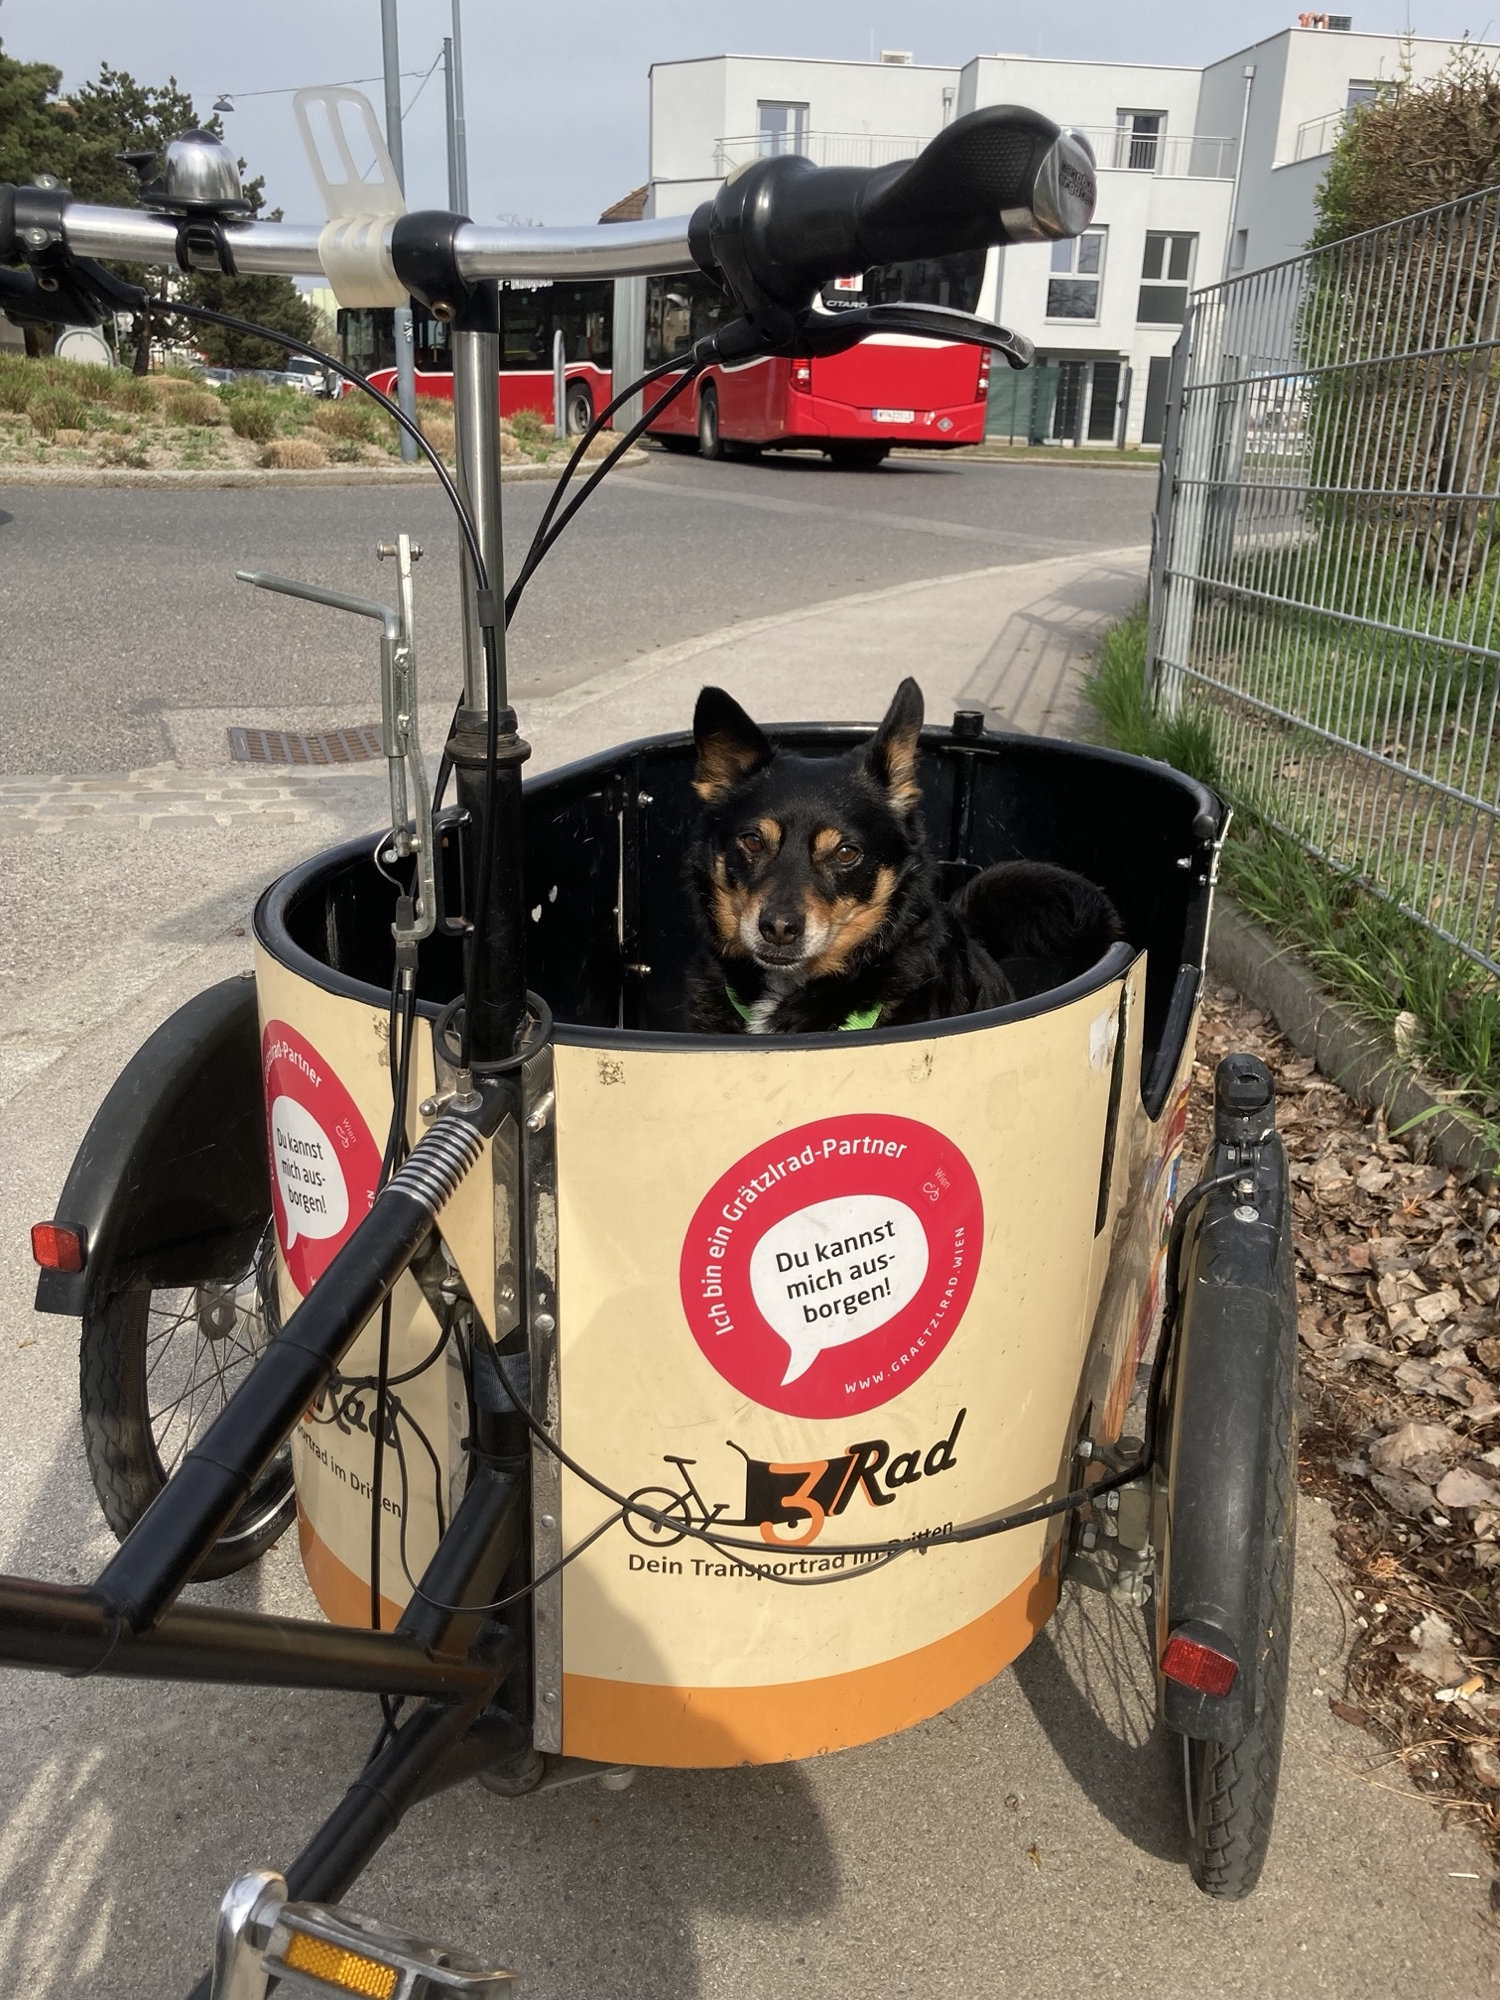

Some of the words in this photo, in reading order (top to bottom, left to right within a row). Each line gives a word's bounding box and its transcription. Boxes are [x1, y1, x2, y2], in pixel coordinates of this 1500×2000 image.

[826, 300, 869, 309] CITARO
[276, 1127, 288, 1149] Du
[287, 1132, 324, 1161] kannst
[342, 1117, 357, 1144] Wien
[281, 1158, 302, 1182] mich
[303, 1165, 326, 1188] aus-
[721, 1136, 908, 1222] Grätzlrad-Partner
[934, 1167, 951, 1190] Wien
[288, 1183, 328, 1215] borgen!
[708, 1225, 733, 1259] ein
[775, 1250, 810, 1273] Du
[814, 1219, 897, 1262] kannst
[701, 1265, 722, 1298] bin
[786, 1268, 843, 1299] mich
[849, 1254, 896, 1281] aus-
[802, 1277, 892, 1324] borgen!
[844, 1226, 965, 1394] WWW.GRAETZLRAD.WIEN
[707, 1303, 734, 1337] Ich
[331, 1456, 346, 1482] im
[350, 1472, 402, 1518] Drien
[628, 1553, 683, 1576] Dein
[690, 1553, 845, 1580] Transportrad
